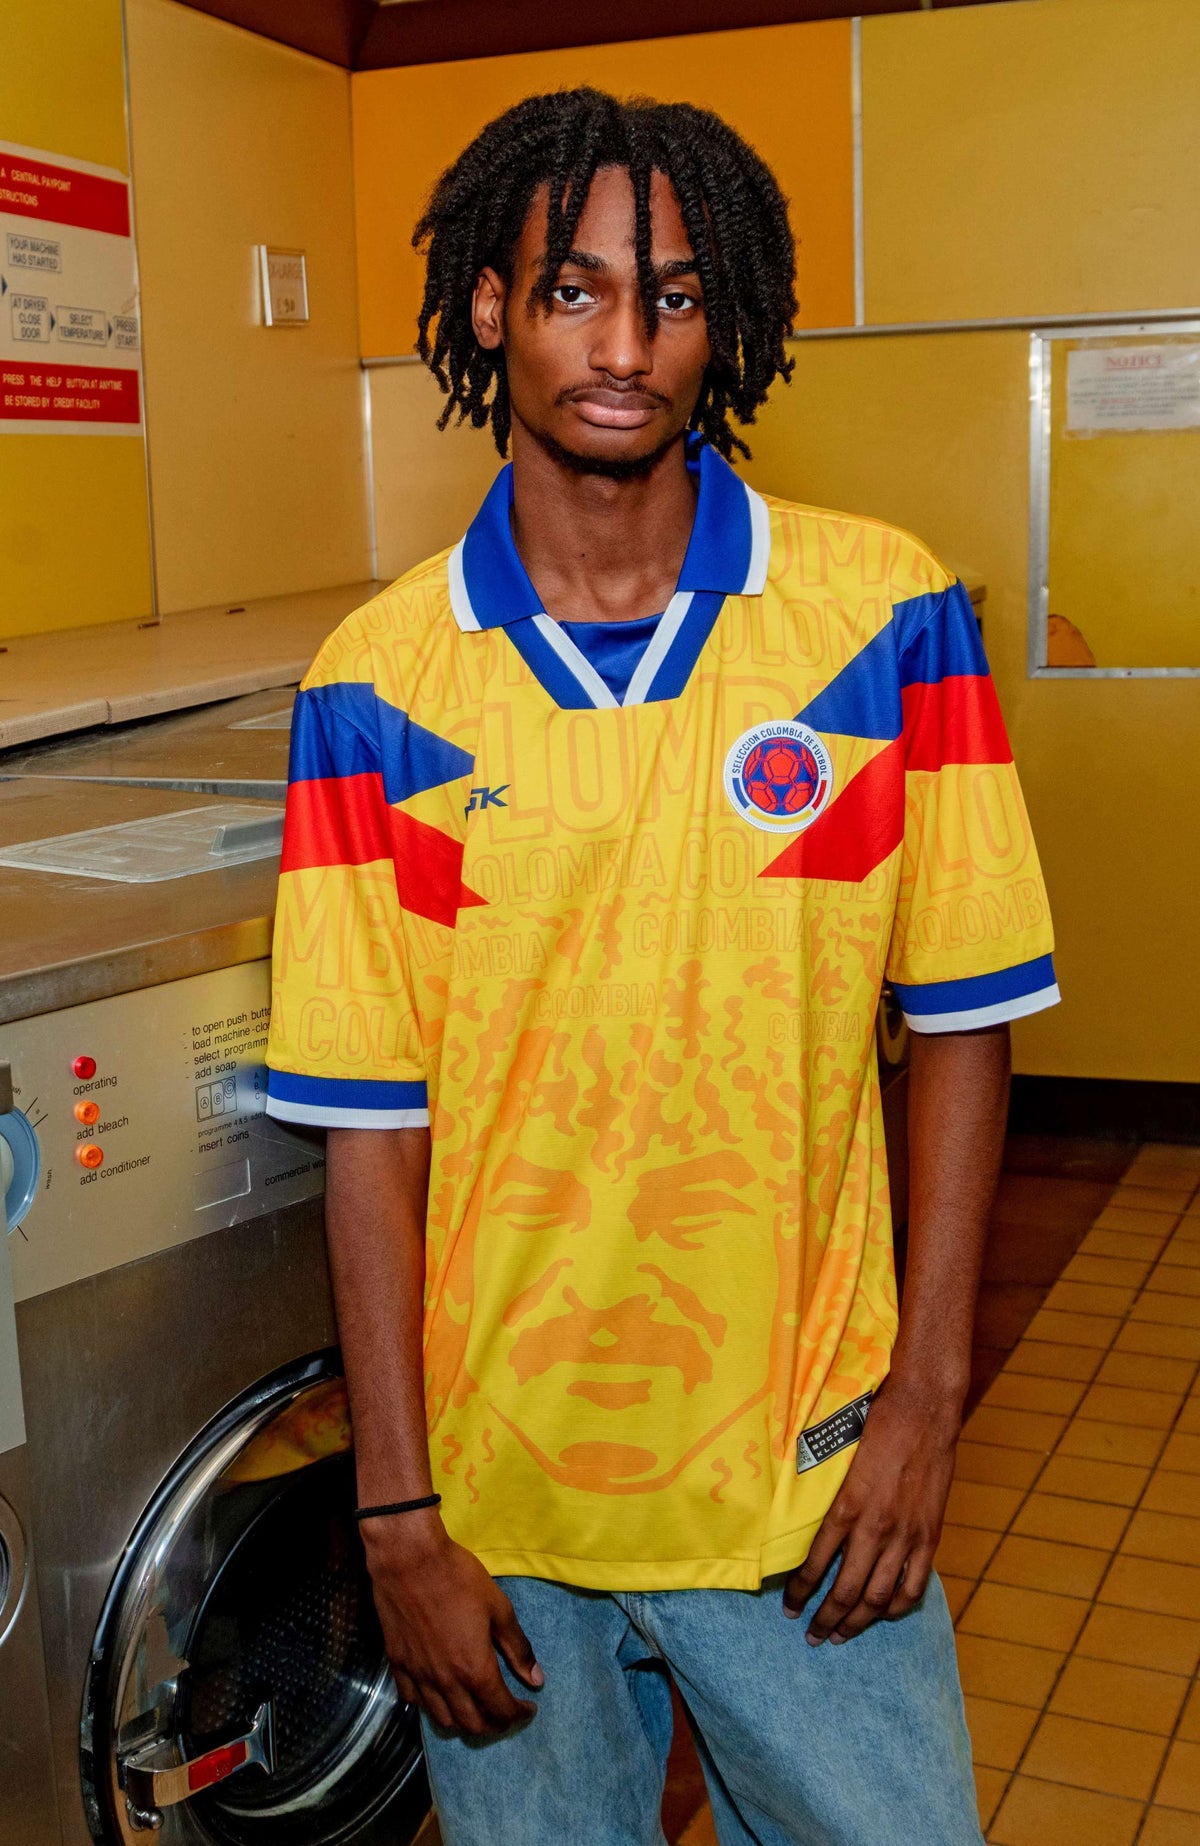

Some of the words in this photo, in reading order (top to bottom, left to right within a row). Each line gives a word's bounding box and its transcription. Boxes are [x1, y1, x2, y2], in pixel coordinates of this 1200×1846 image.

[0, 168, 6, 178] A
[11, 169, 41, 186] CENTRAL
[41, 176, 71, 192] PAYPOINT
[10, 239, 28, 250] YOUR
[29, 241, 59, 256] MACHINE
[12, 253, 27, 265] HAS
[28, 255, 58, 270] STARTED
[13, 298, 21, 308] AT
[23, 299, 46, 311] DRYER
[19, 312, 42, 326] CLOSE
[69, 313, 94, 326] SELECT
[116, 319, 137, 333] PRESS
[21, 327, 42, 339] DOOR
[59, 326, 105, 341] TEMPERATURE
[117, 334, 138, 346] START
[2, 373, 25, 386] PRESS
[30, 375, 42, 387] THE
[46, 376, 62, 388] HELP
[66, 378, 89, 389] BUTTON
[89, 379, 98, 389] AT
[99, 380, 122, 391] ANYTIME
[4, 395, 14, 406] BE
[15, 395, 41, 408] STORED
[41, 397, 51, 408] BY
[53, 397, 75, 409] CREDIT
[76, 399, 101, 410] FACILITY
[731, 733, 761, 775] SELECCION
[760, 726, 804, 739] COLOMBIA
[803, 734, 815, 747] DE
[811, 743, 828, 776] FUTBOL
[192, 1026, 201, 1037] to
[202, 1020, 225, 1034] open
[226, 1012, 248, 1027] push
[192, 1039, 212, 1051] load
[214, 1028, 250, 1045] machine
[193, 1050, 221, 1066] select
[194, 1065, 212, 1080] add
[215, 1060, 237, 1074] soap
[254, 1071, 260, 1079] A
[73, 1075, 118, 1096] operating
[254, 1092, 261, 1101] C
[76, 1127, 95, 1141] add
[97, 1115, 129, 1134] bleach
[197, 1121, 233, 1139] programme
[197, 1138, 223, 1154] insert
[226, 1129, 250, 1145] coins
[79, 1170, 98, 1186] add
[100, 1154, 152, 1179] conditioner
[264, 1164, 311, 1187] commercial
[807, 1410, 854, 1443] ASPHALT
[811, 1422, 853, 1451] SOCIAL
[816, 1436, 845, 1458] KLUB
